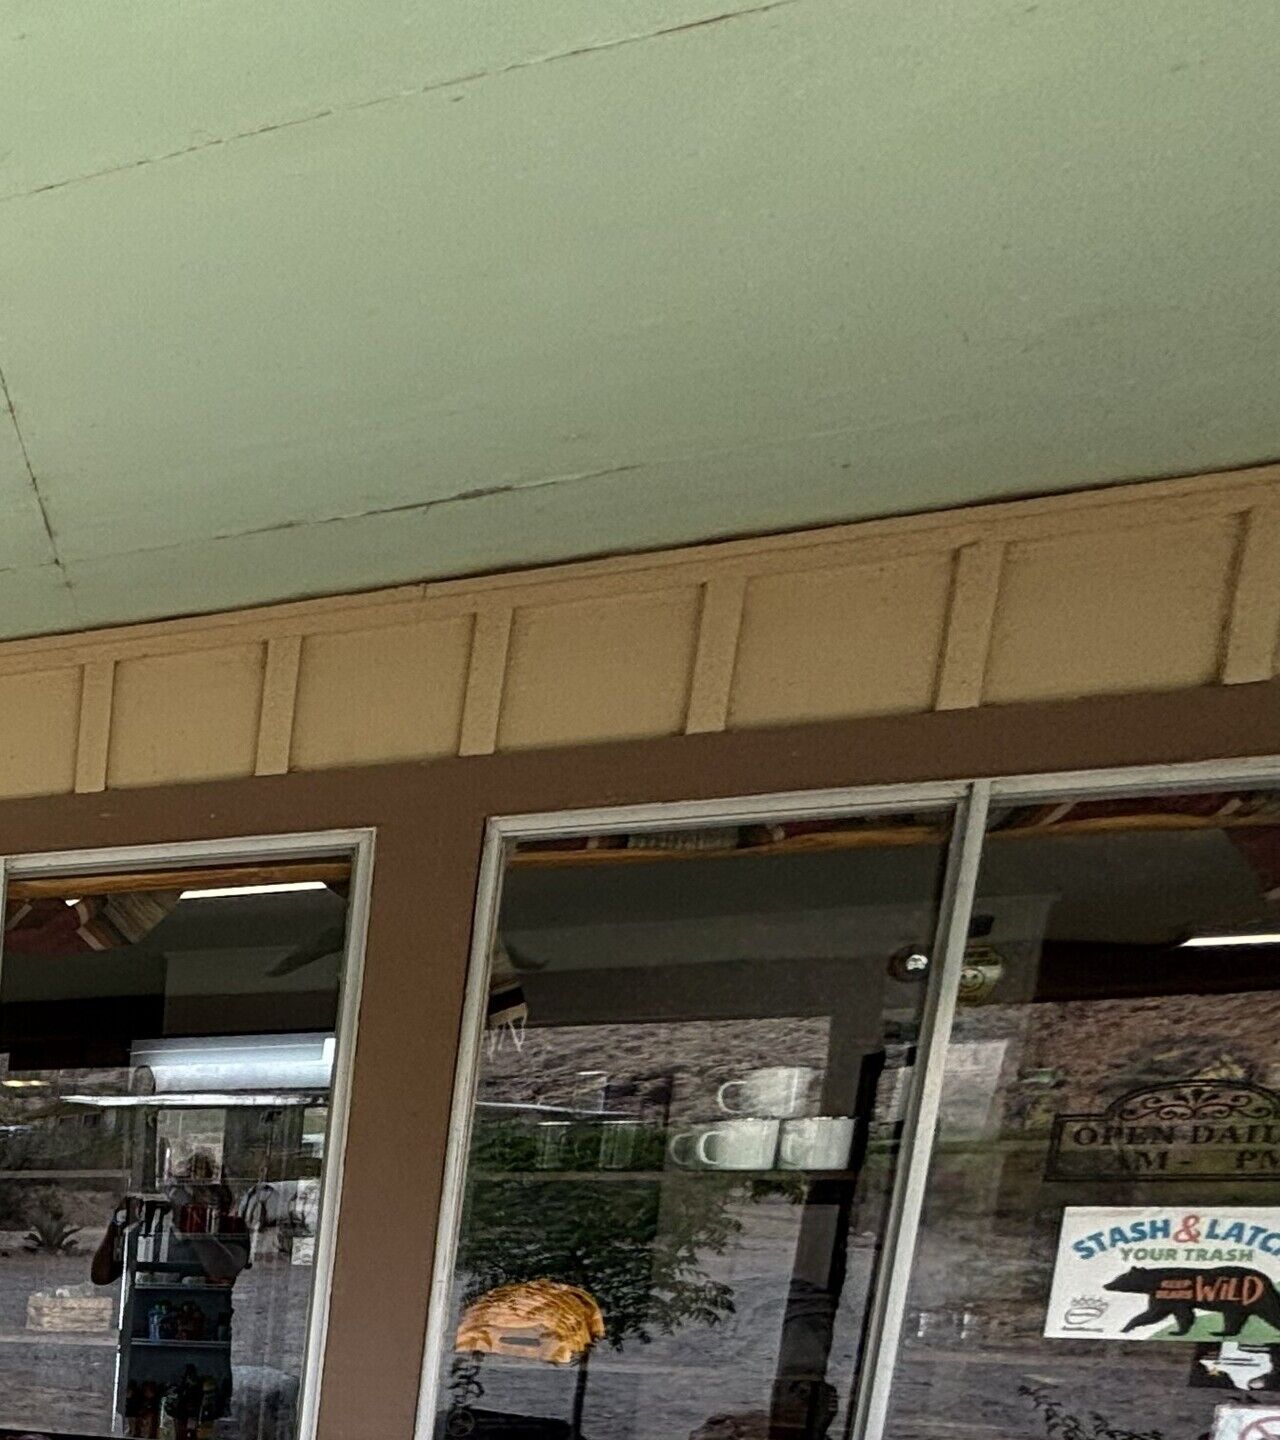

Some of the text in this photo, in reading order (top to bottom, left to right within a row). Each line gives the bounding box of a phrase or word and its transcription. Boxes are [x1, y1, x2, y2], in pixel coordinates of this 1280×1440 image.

[1073, 1125, 1175, 1146] OPEN
[1072, 1218, 1171, 1260] STASH
[1173, 1214, 1201, 1244] &
[1120, 1247, 1253, 1262] YOUR TRASH
